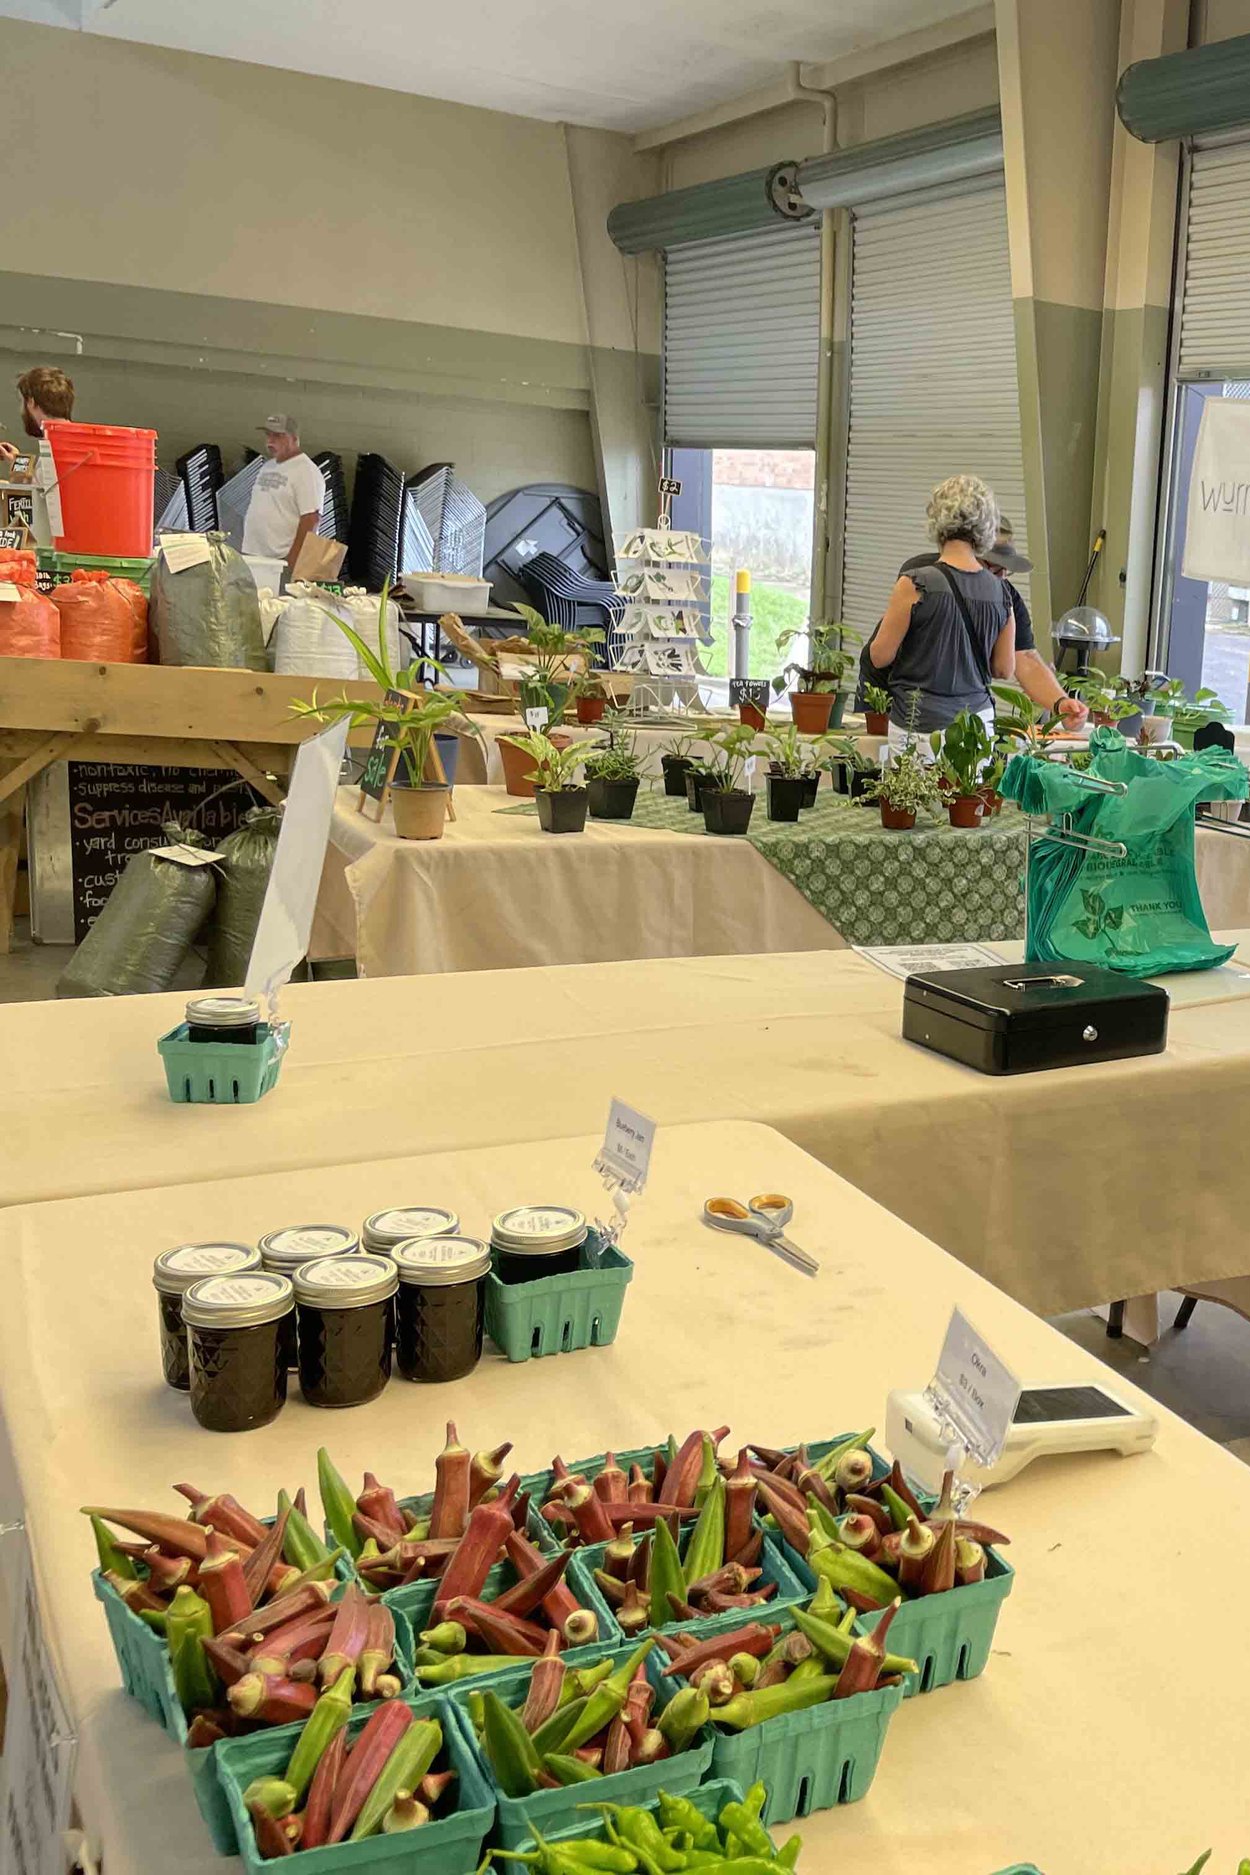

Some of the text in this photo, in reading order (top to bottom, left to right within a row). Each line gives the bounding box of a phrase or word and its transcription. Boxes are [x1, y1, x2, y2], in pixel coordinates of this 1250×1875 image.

[662, 480, 678, 491] $2
[78, 782, 135, 797] suppress
[74, 803, 161, 829] Services
[83, 832, 116, 855] yard
[1130, 900, 1183, 912] THANK YOU
